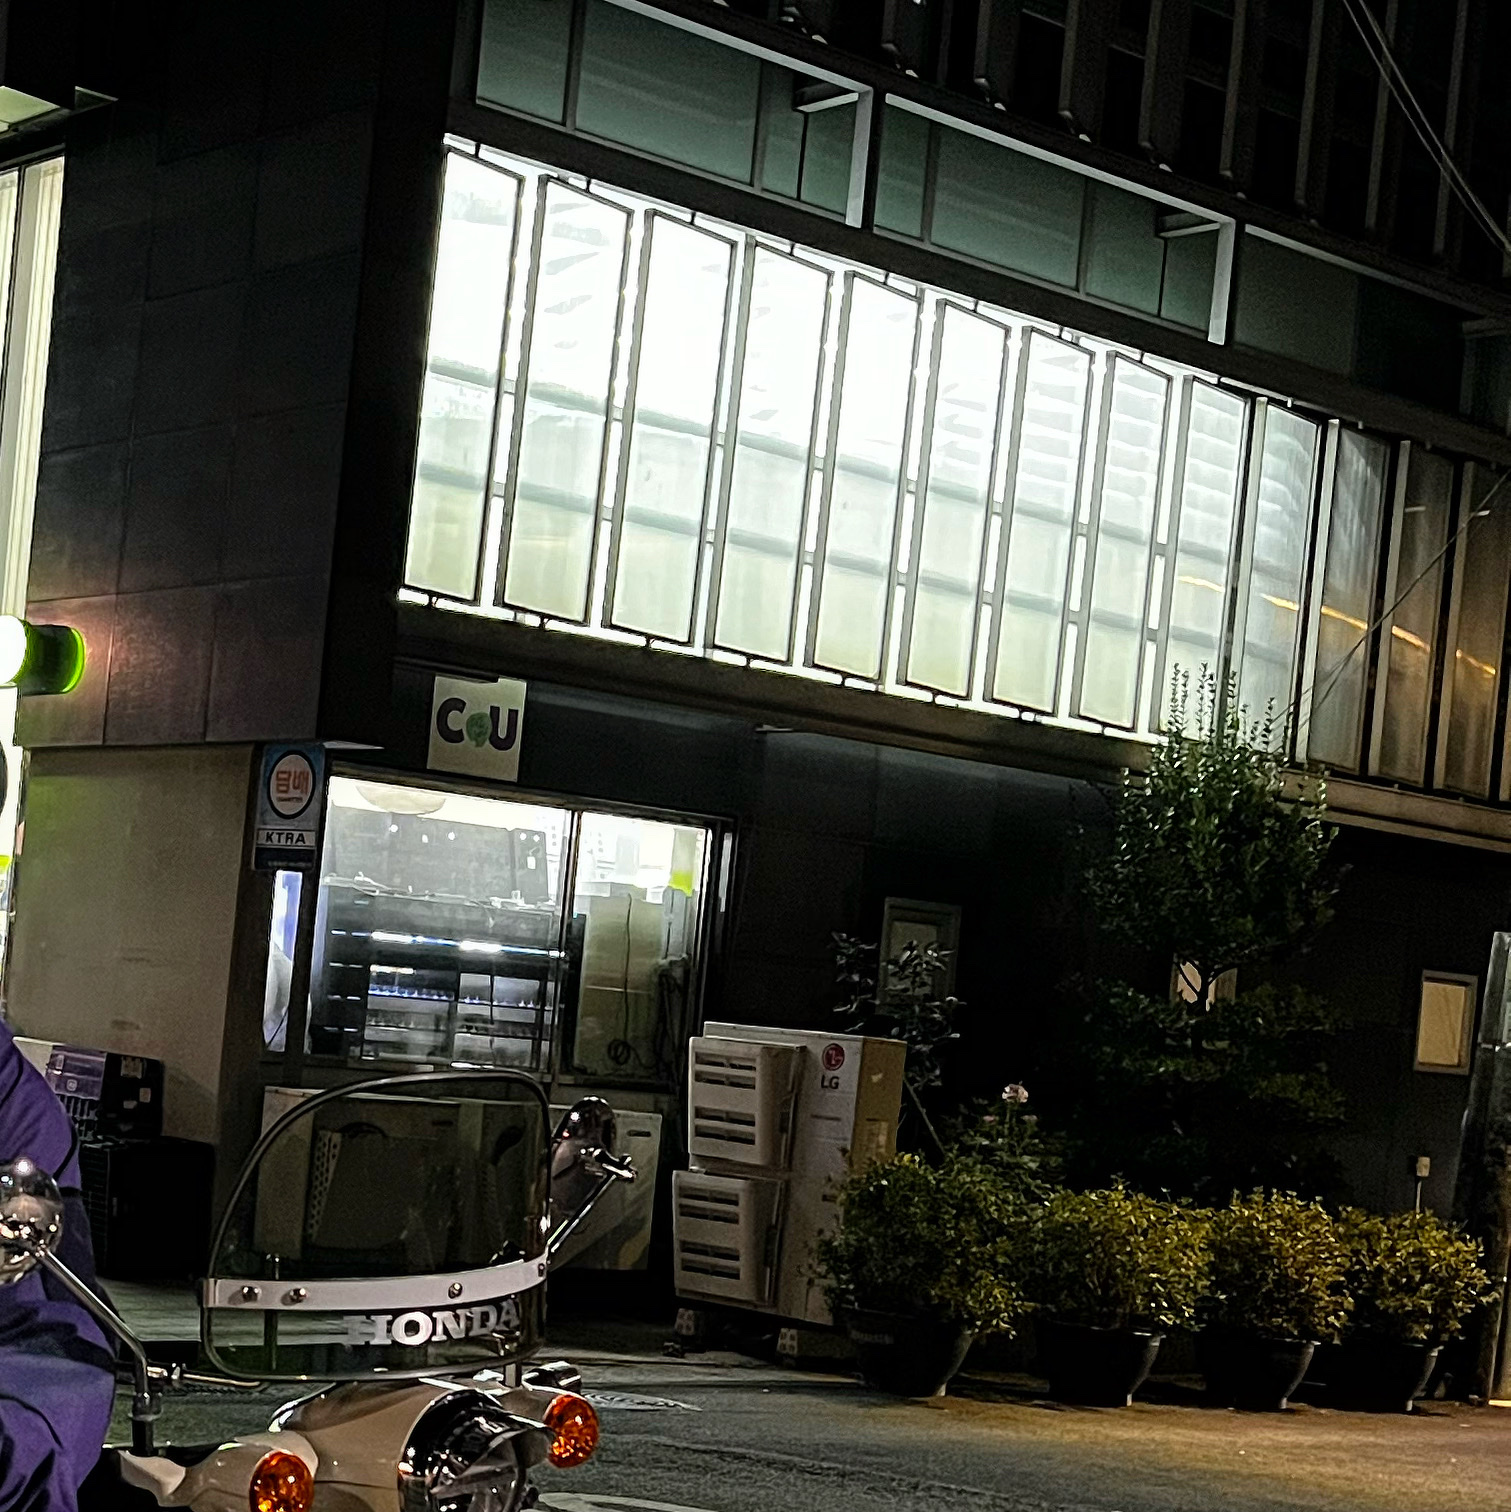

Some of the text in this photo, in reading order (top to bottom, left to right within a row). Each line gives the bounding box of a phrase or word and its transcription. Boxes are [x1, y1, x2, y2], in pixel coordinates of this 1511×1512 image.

[435, 697, 520, 752] CU
[275, 769, 310, 796] 담배
[265, 831, 307, 845] KTRA
[820, 1074, 840, 1090] LG
[343, 1294, 521, 1346] HONDA
